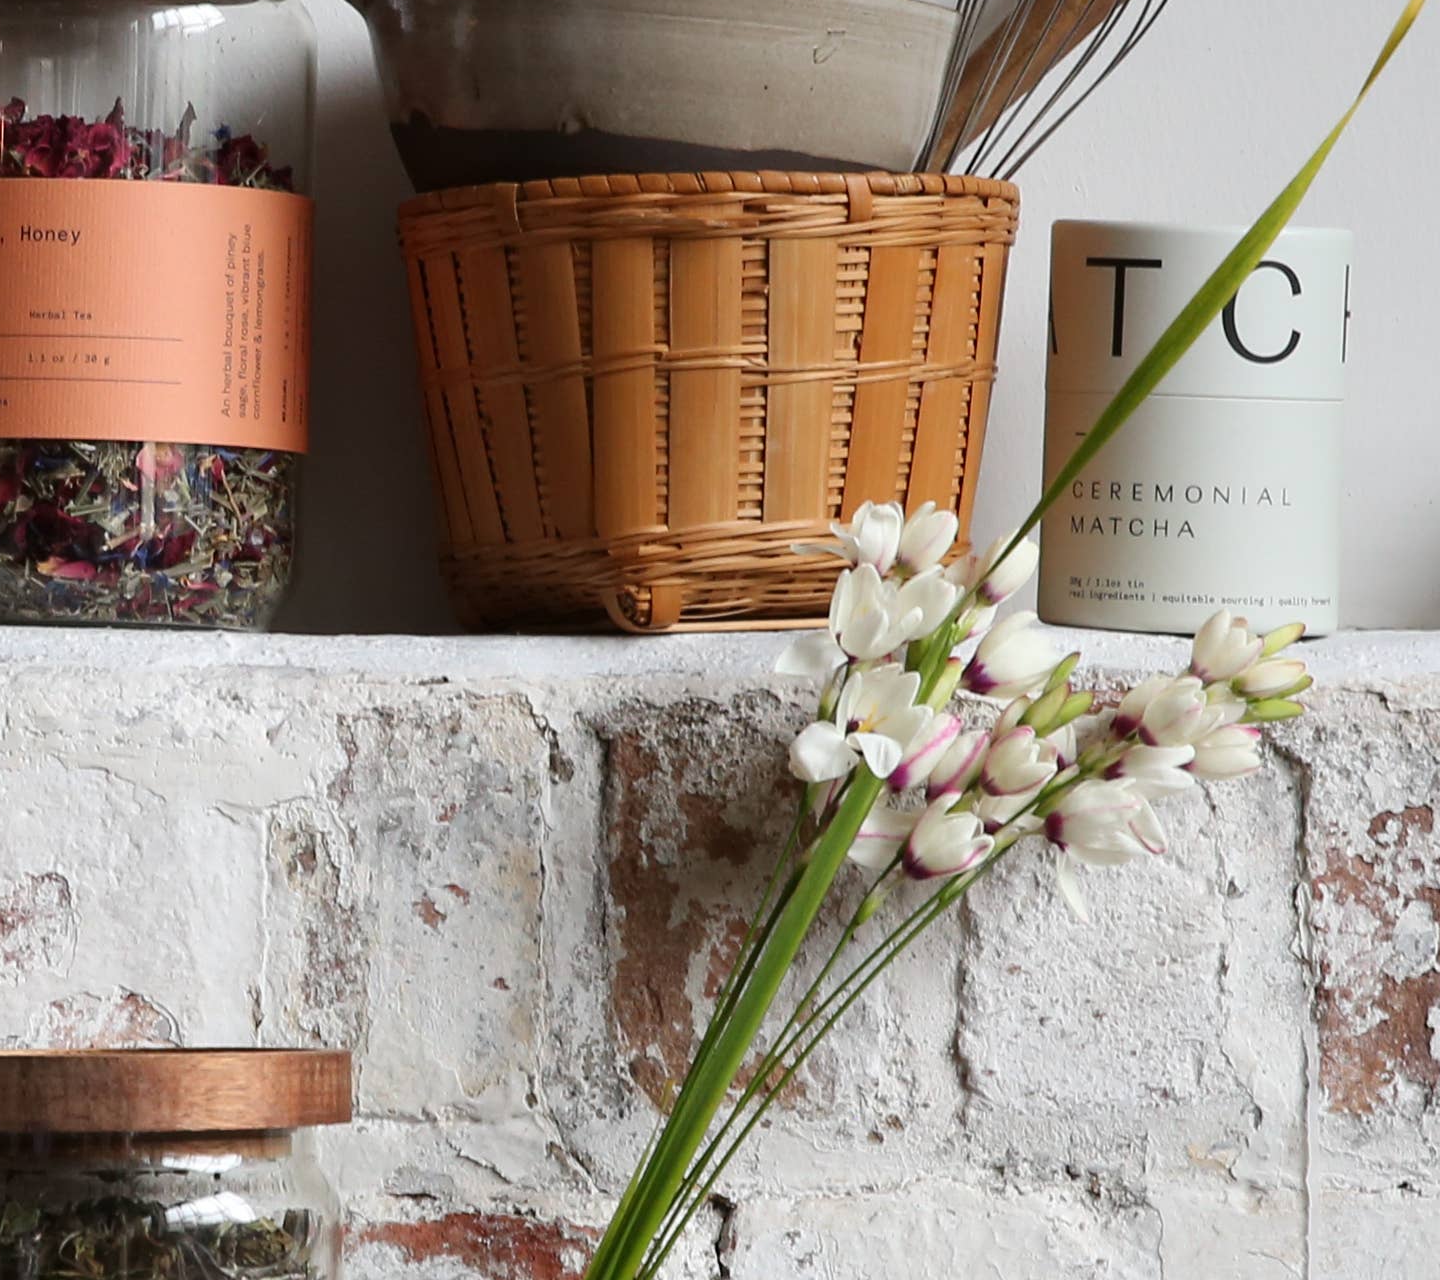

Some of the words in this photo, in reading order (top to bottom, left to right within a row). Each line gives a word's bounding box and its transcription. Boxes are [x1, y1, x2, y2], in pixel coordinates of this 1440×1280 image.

[21, 225, 80, 246] Honey
[243, 224, 252, 253] blue
[227, 233, 238, 269] piney
[225, 274, 235, 287] of
[241, 258, 251, 304] vibrant
[29, 310, 66, 320] Herbal
[73, 311, 92, 320] Tea
[224, 291, 235, 347] bouquet
[1050, 257, 1351, 364] TC
[254, 335, 263, 344] &
[222, 352, 233, 394] herbal
[239, 346, 248, 379] floral
[252, 348, 263, 420] cornflower
[222, 399, 232, 417] An
[1072, 480, 1292, 507] CEREMONIAL
[1070, 516, 1195, 539] MATCHA
[1128, 580, 1144, 589] tin
[1089, 590, 1145, 601] ingredients
[1162, 594, 1215, 605] equitable
[1221, 596, 1264, 608] sourcing
